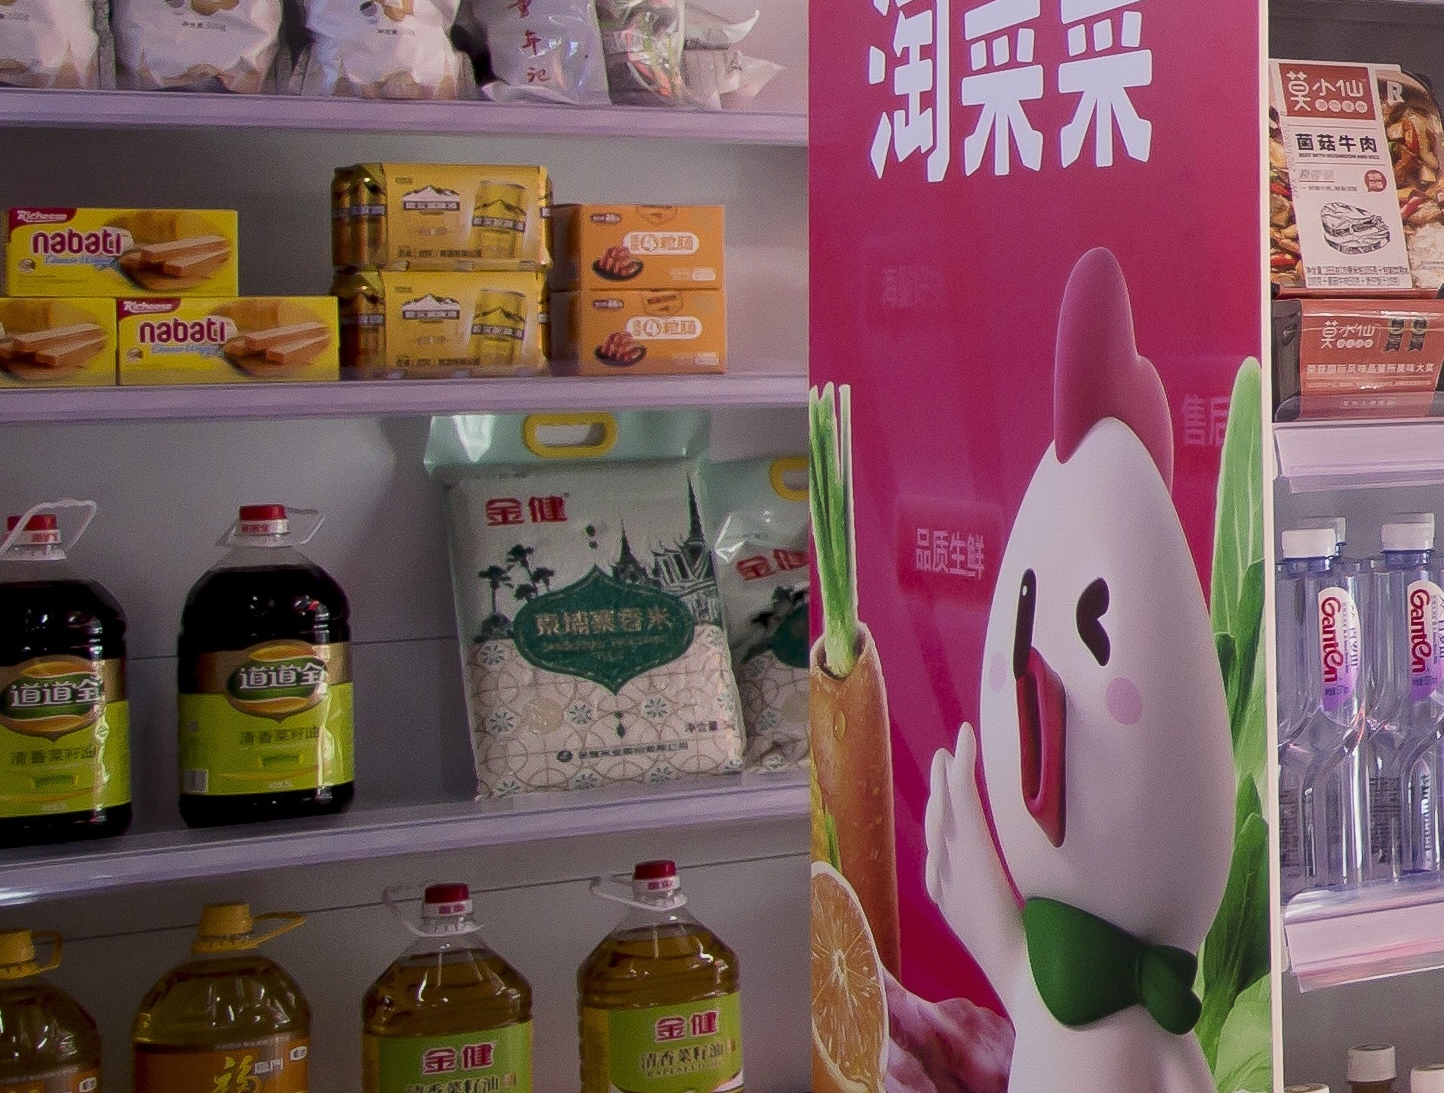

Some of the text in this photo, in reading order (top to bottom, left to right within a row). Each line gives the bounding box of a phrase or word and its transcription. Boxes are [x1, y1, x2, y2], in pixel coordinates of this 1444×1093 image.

[1286, 71, 1364, 112] 莫小仙
[1295, 133, 1378, 153] 菌菇牛肉
[32, 228, 123, 255] nabati
[139, 318, 226, 343] nabati
[1321, 320, 1375, 349] 莫小仙
[485, 496, 567, 526] 金健
[239, 663, 328, 690] 道道全
[11, 678, 105, 708] 道道全
[655, 1010, 720, 1042] 金健
[422, 1043, 495, 1075] 金健
